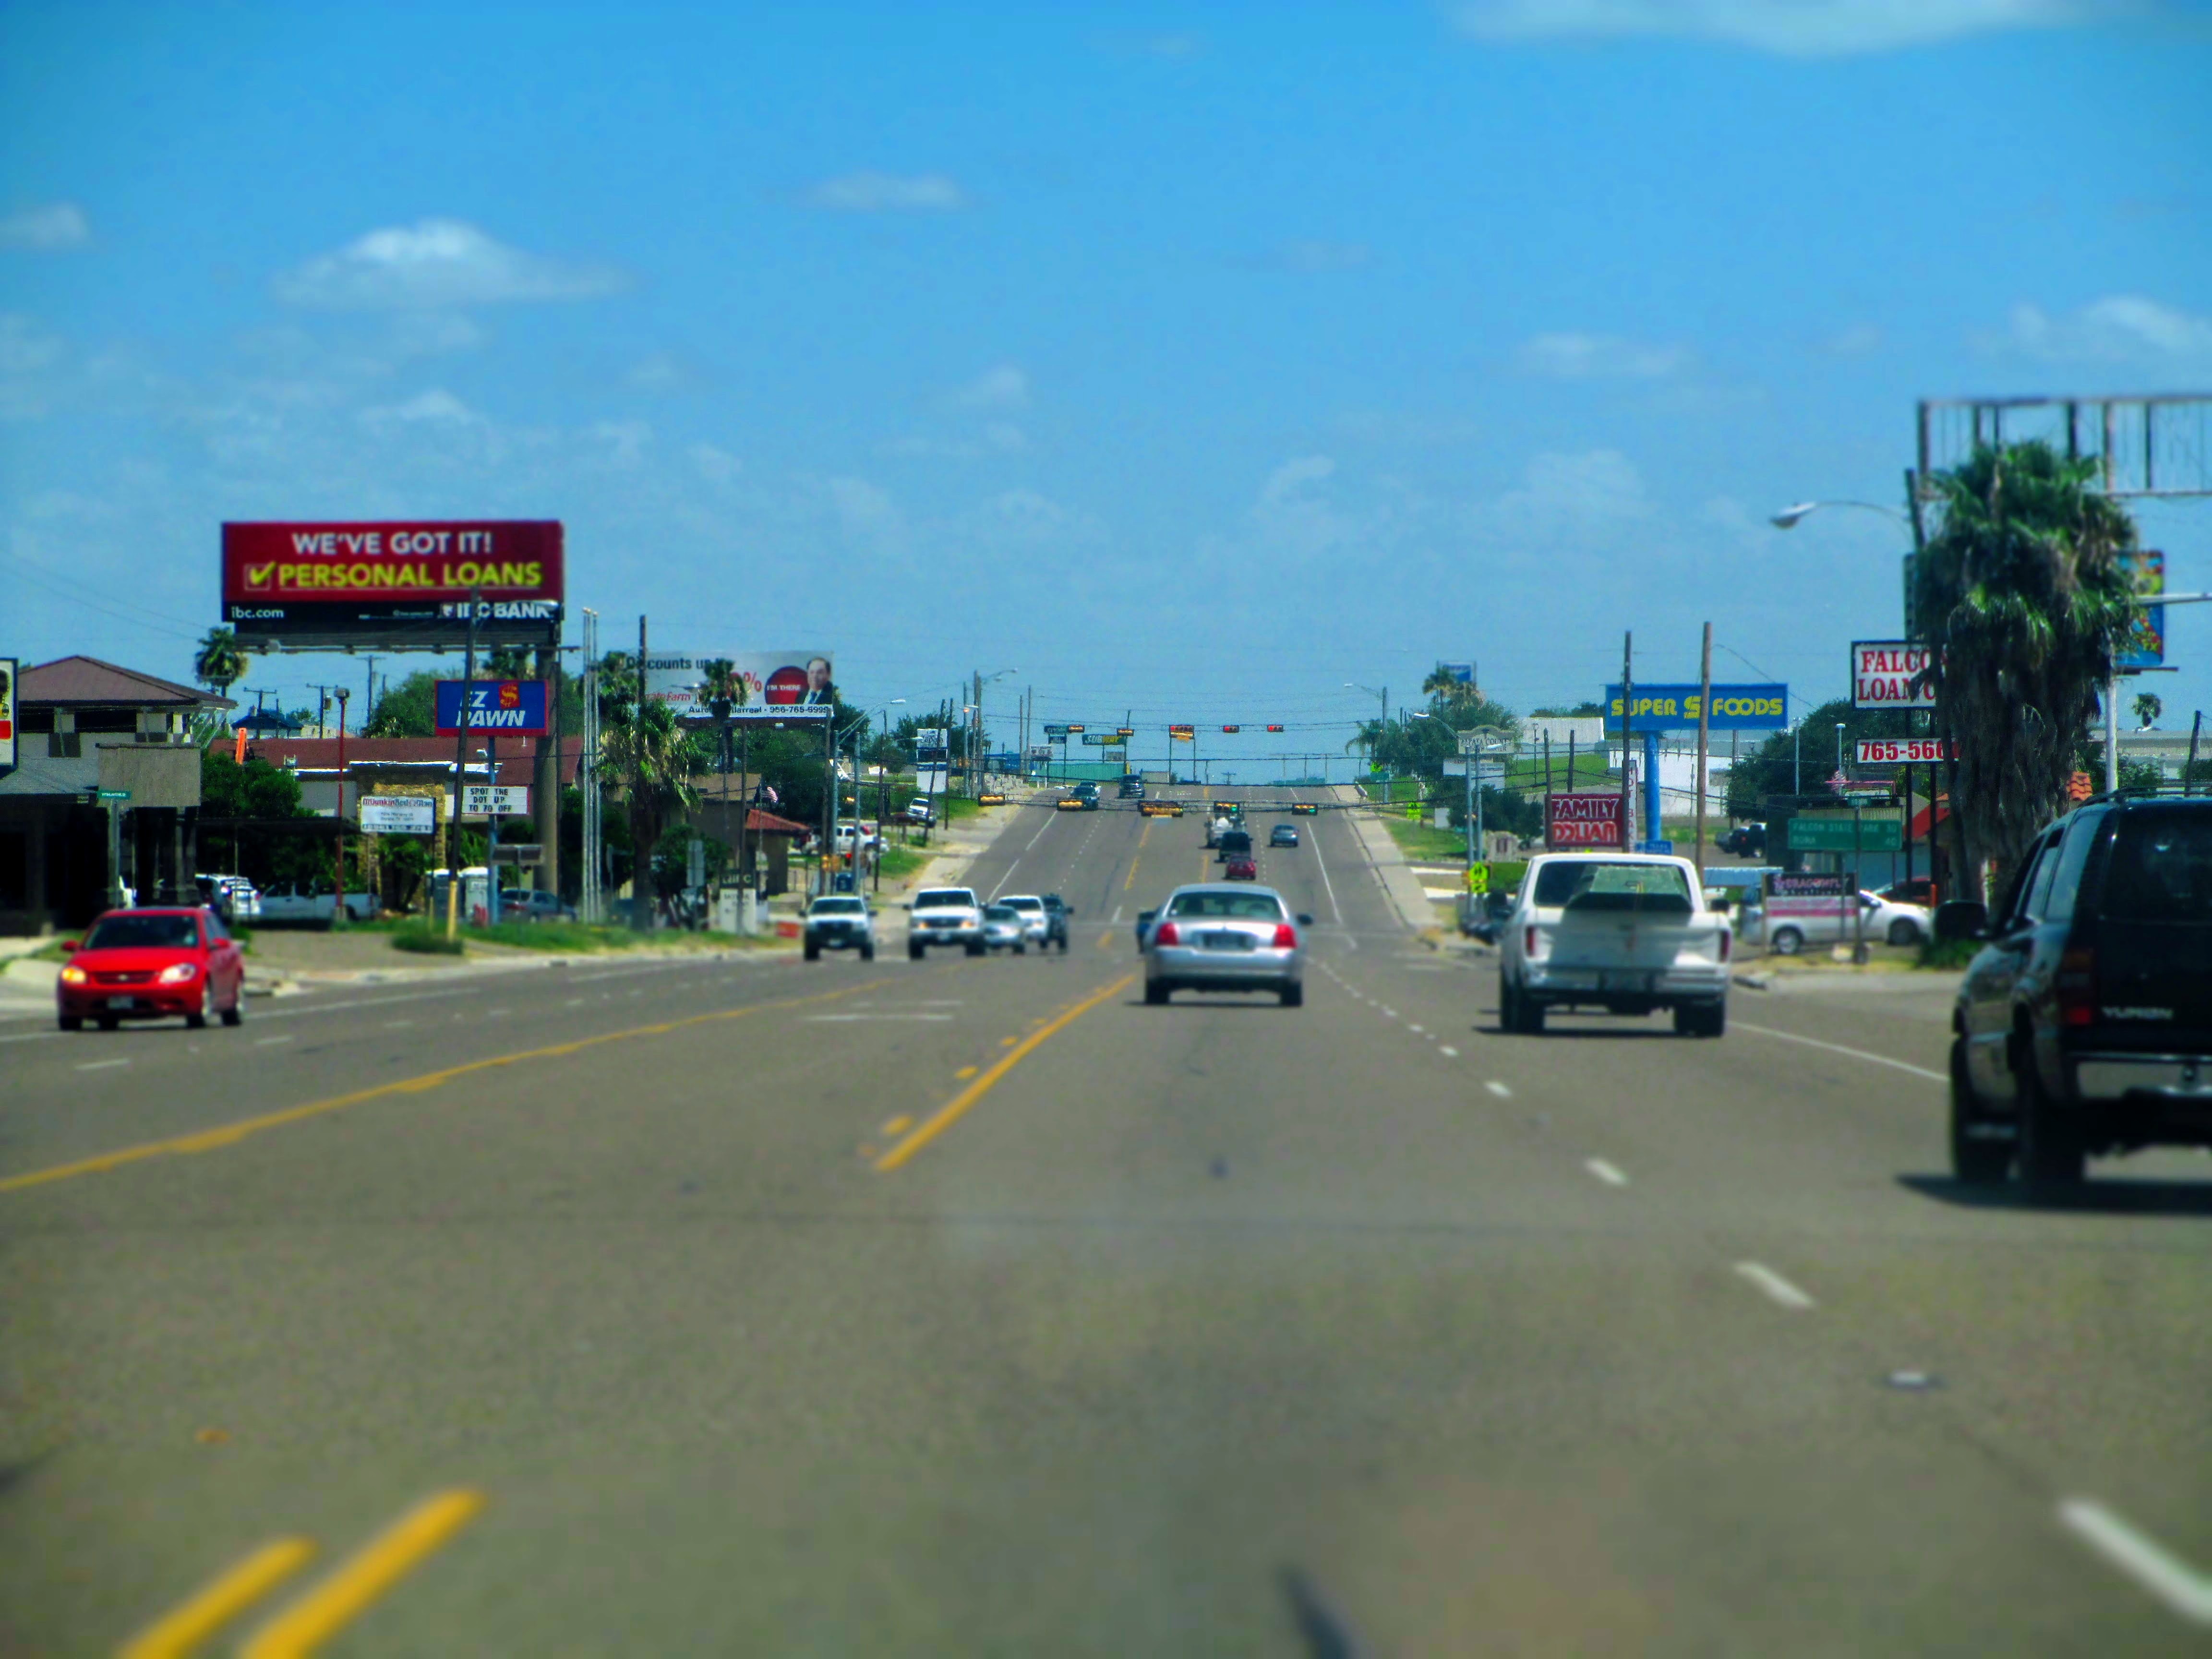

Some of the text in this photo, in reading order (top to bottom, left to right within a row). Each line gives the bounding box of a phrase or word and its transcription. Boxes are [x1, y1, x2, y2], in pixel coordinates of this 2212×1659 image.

[291, 531, 492, 555] WE'VE GOT IT!
[278, 561, 543, 587] PERSONAL LOANS
[231, 606, 285, 618] ibc.com
[1611, 697, 1677, 716] SUPER
[1712, 698, 1783, 716] FOODS
[1551, 798, 1620, 819] FAMILY
[1551, 821, 1618, 842] DOLLAR
